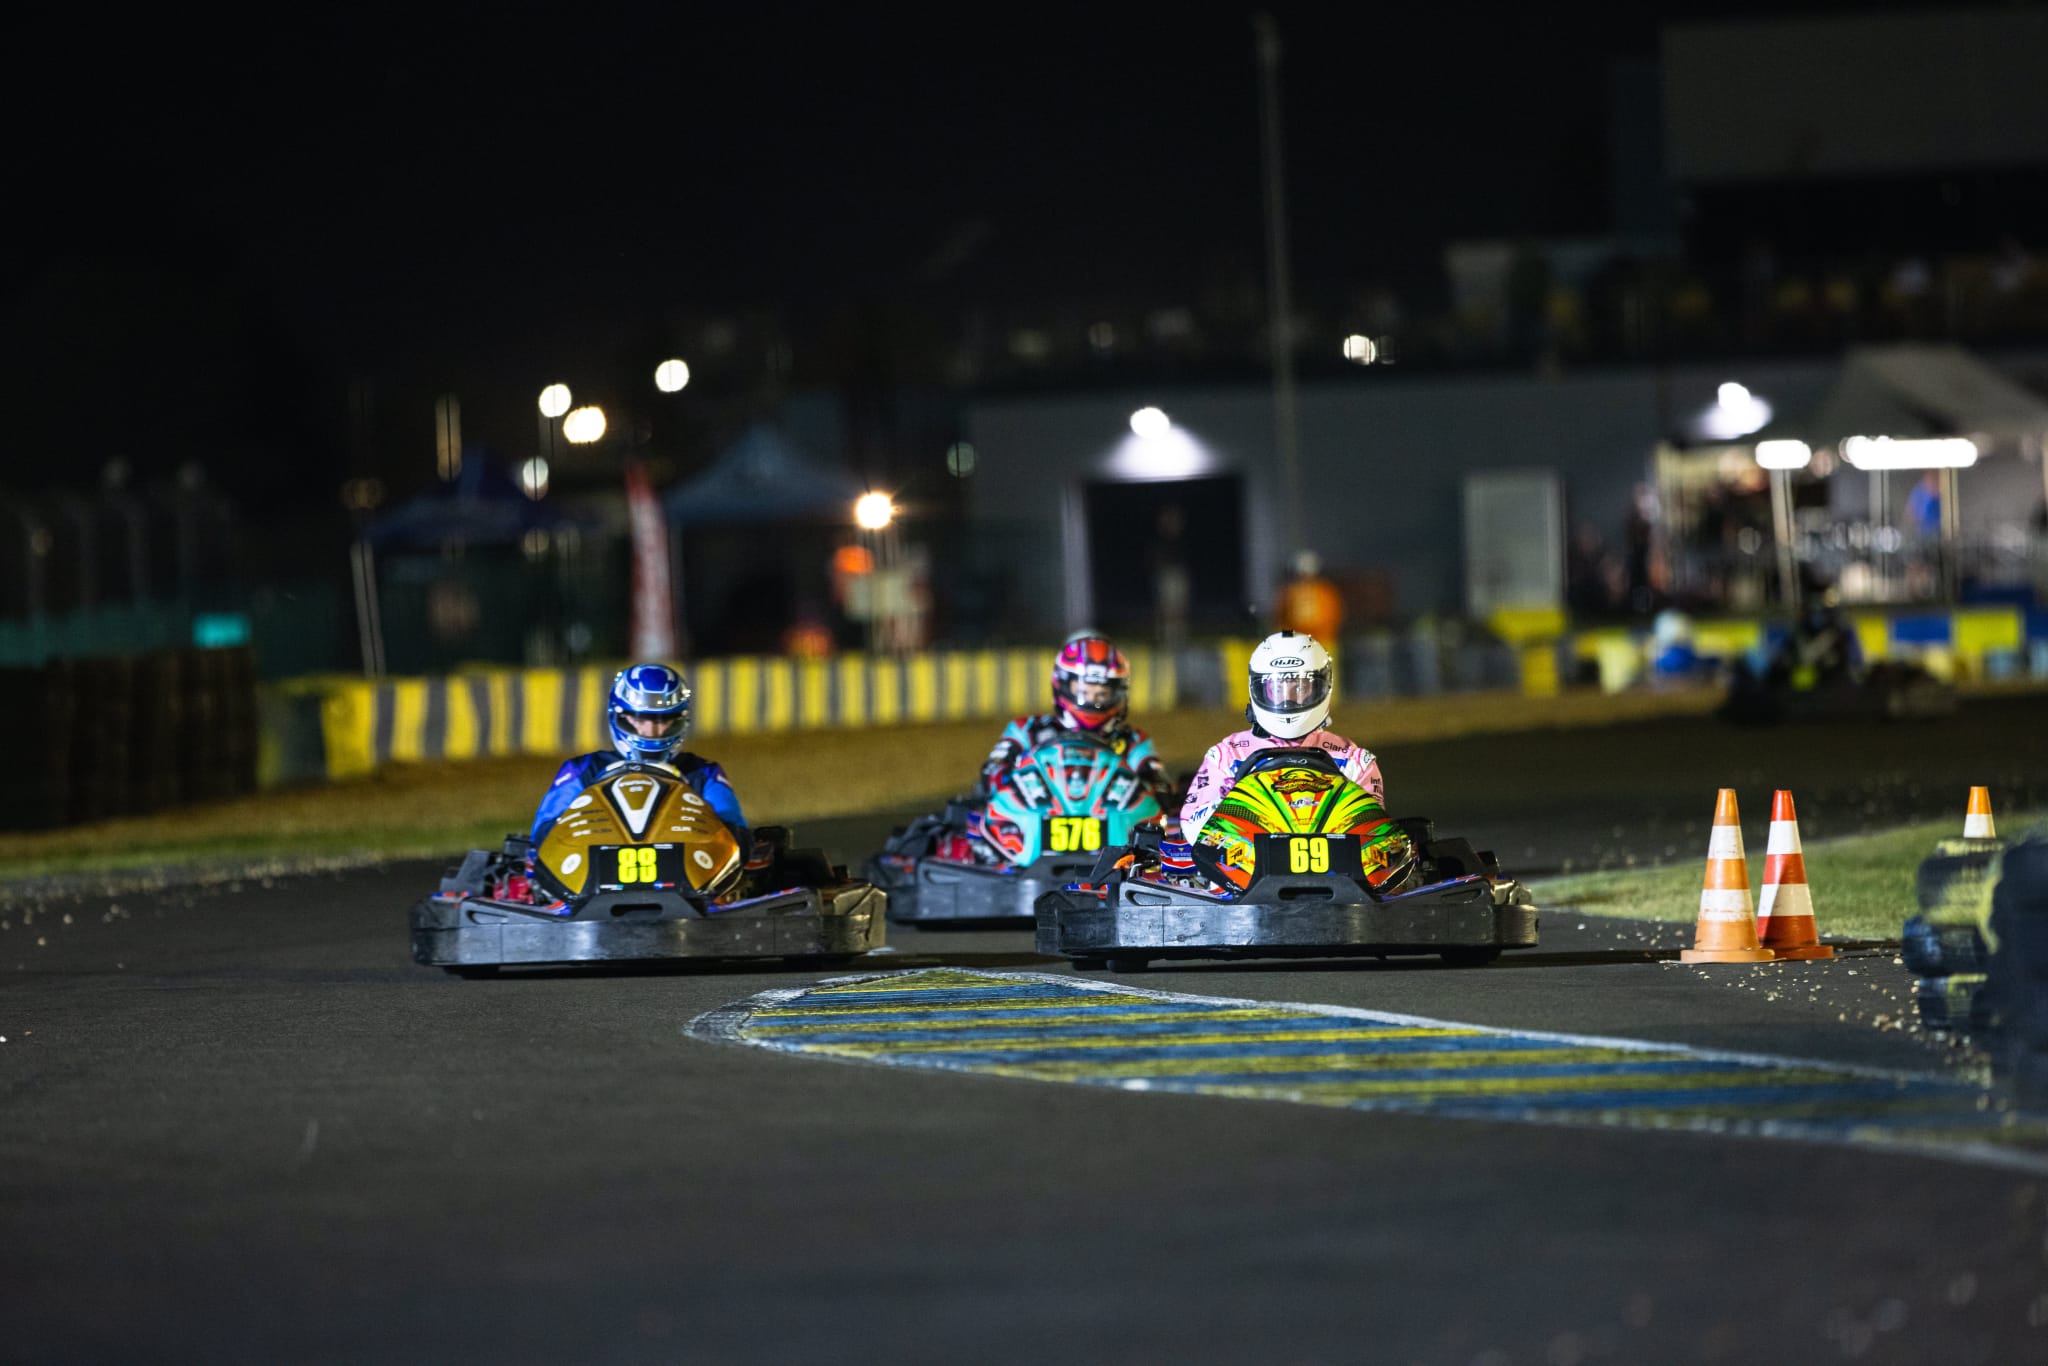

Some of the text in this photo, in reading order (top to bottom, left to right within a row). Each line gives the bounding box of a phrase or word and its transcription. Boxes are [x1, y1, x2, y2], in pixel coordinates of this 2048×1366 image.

[1261, 672, 1315, 684] FANATEC
[1321, 741, 1349, 755] Claro
[1050, 816, 1101, 852] 576
[1289, 837, 1330, 874] 69
